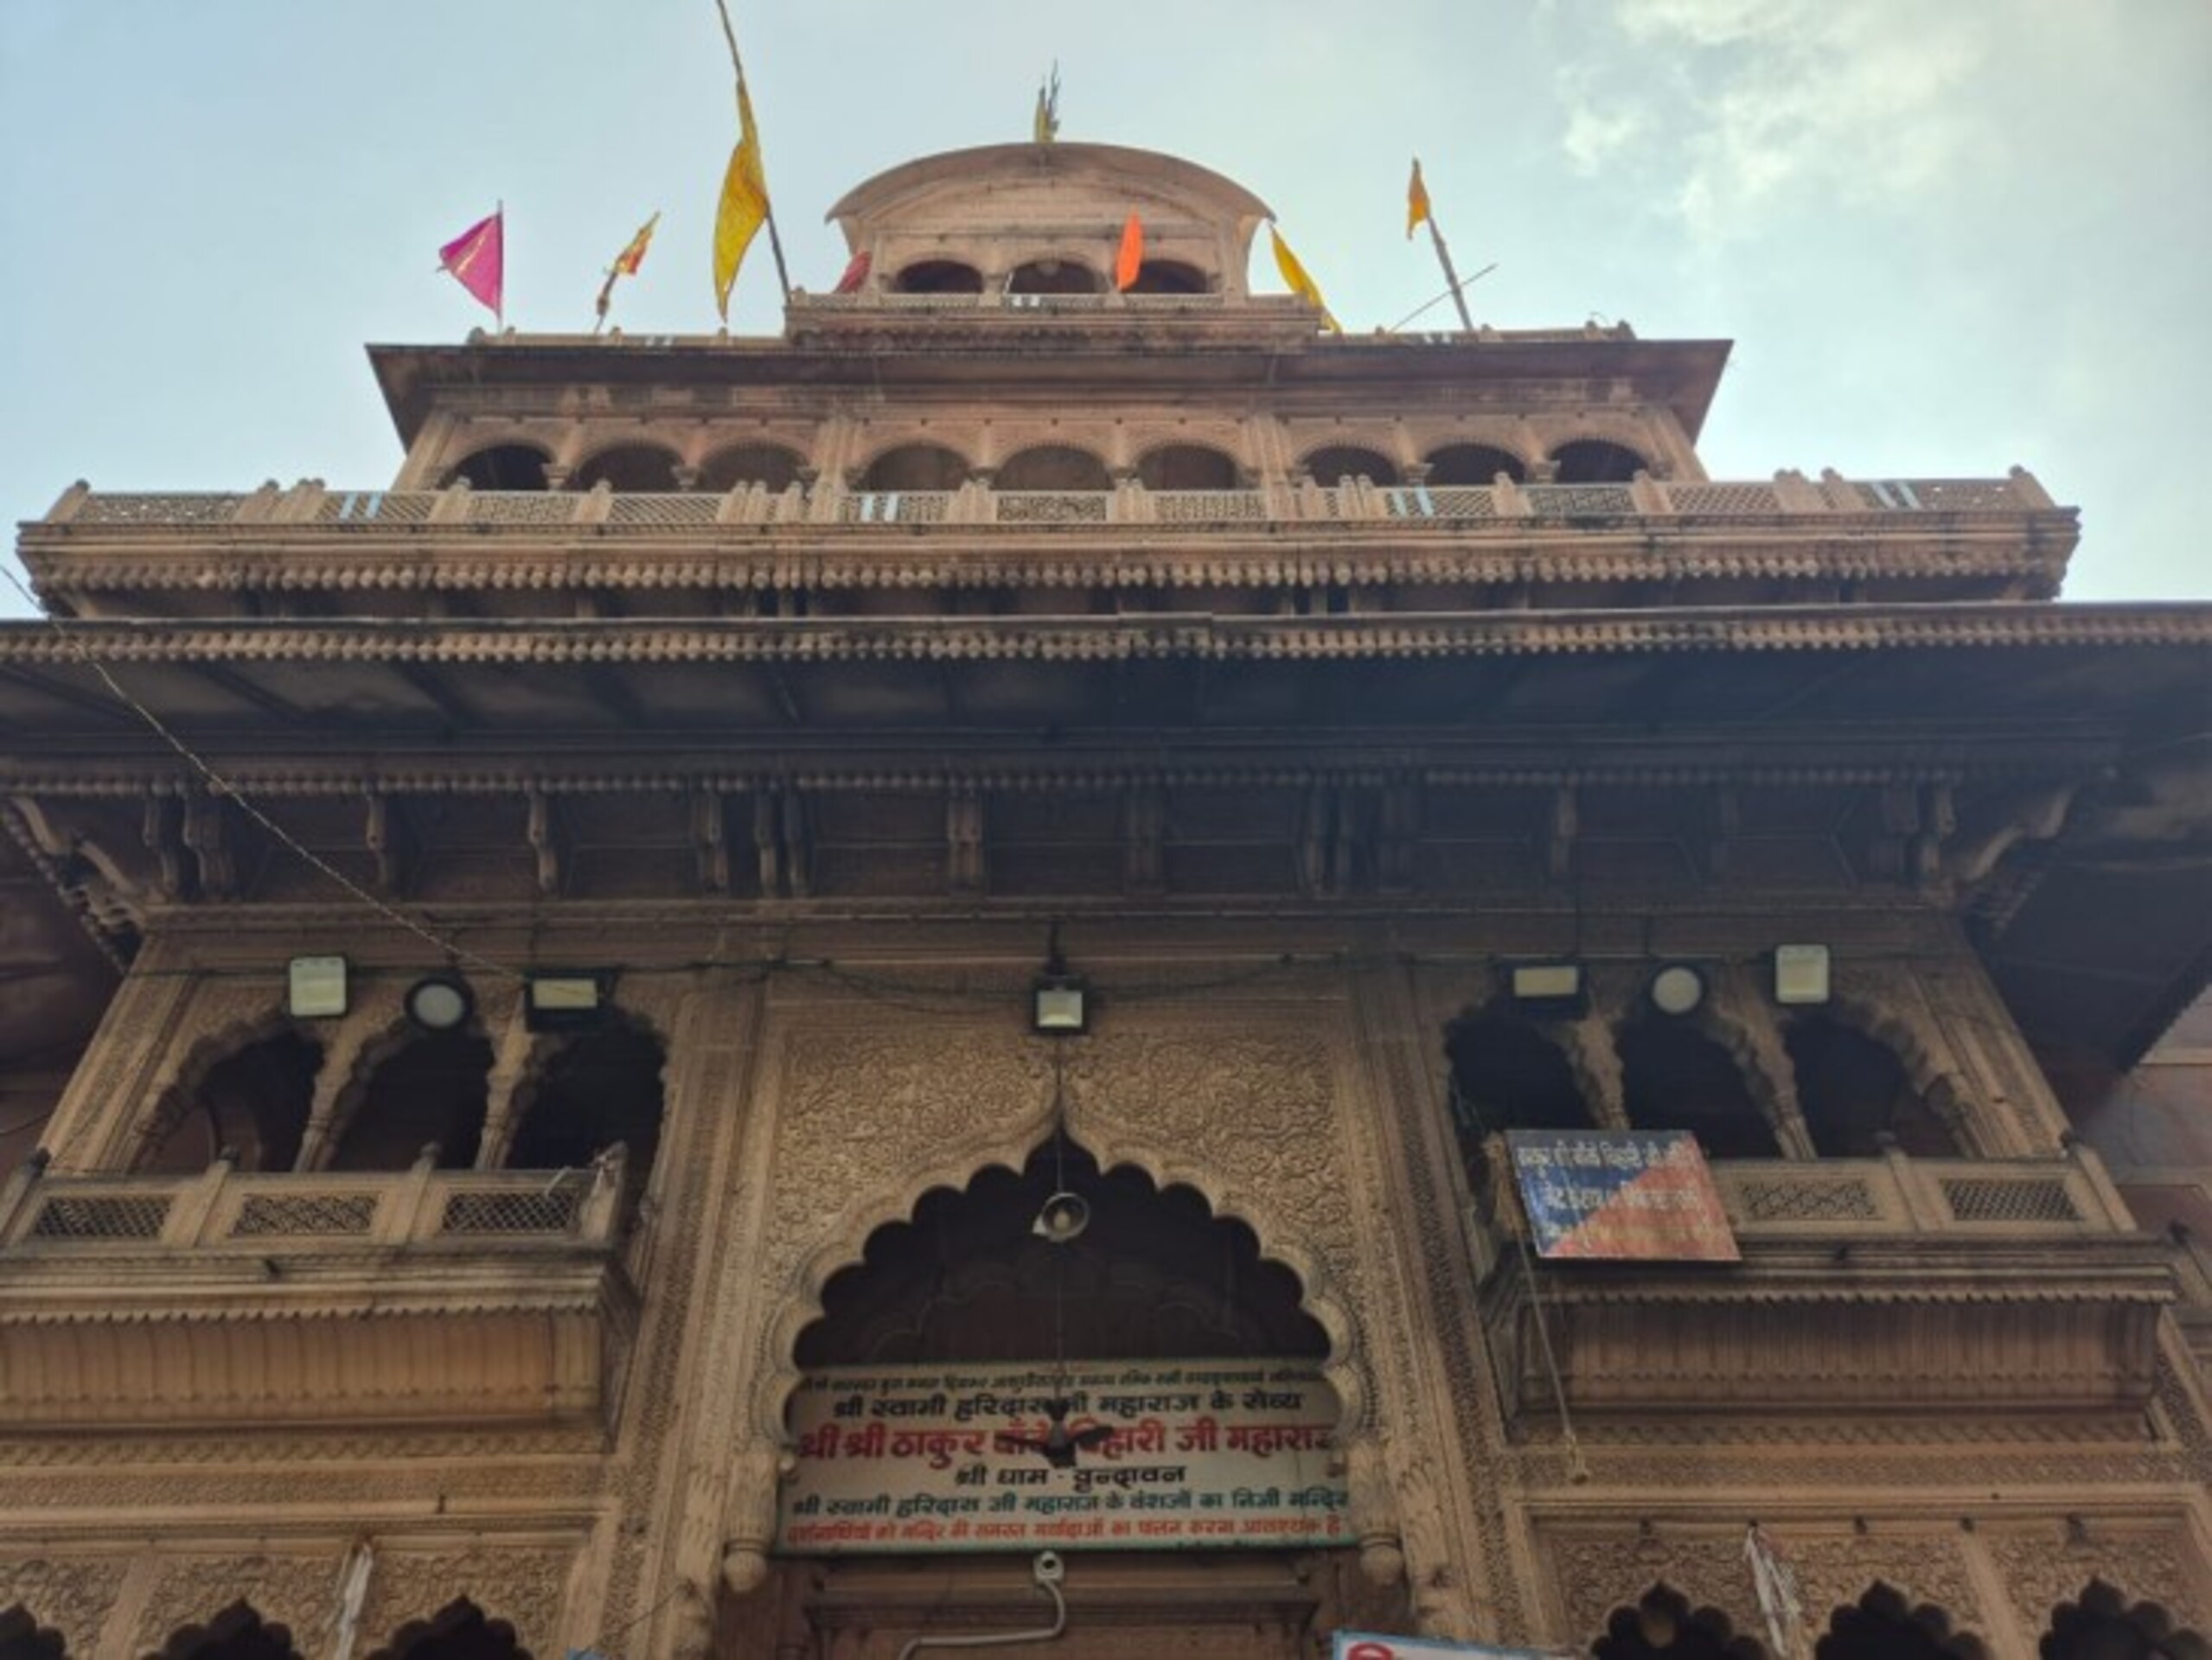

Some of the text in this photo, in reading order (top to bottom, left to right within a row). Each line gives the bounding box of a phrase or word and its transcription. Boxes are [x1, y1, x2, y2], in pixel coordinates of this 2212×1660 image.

[833, 1394, 862, 1418] श्री
[872, 1393, 947, 1416] स्वामी
[1098, 1394, 1201, 1419] महाराज
[1211, 1389, 1234, 1411] के
[799, 1422, 841, 1459] श्री
[844, 1421, 886, 1459] श्री
[891, 1429, 987, 1469] ठाकुर
[1175, 1415, 1218, 1453] जी
[955, 1463, 988, 1485] श्री
[995, 1468, 1049, 1485] धाम
[1072, 1465, 1187, 1493] वृन्दावन
[793, 1492, 821, 1516] श्री
[827, 1492, 891, 1515] स्वामी
[896, 1492, 980, 1517] हरिदास
[988, 1491, 1017, 1512] जी
[1024, 1494, 1099, 1514] महाराज
[1105, 1491, 1124, 1510] के
[1199, 1491, 1224, 1509] का
[1231, 1486, 1280, 1509] निजी
